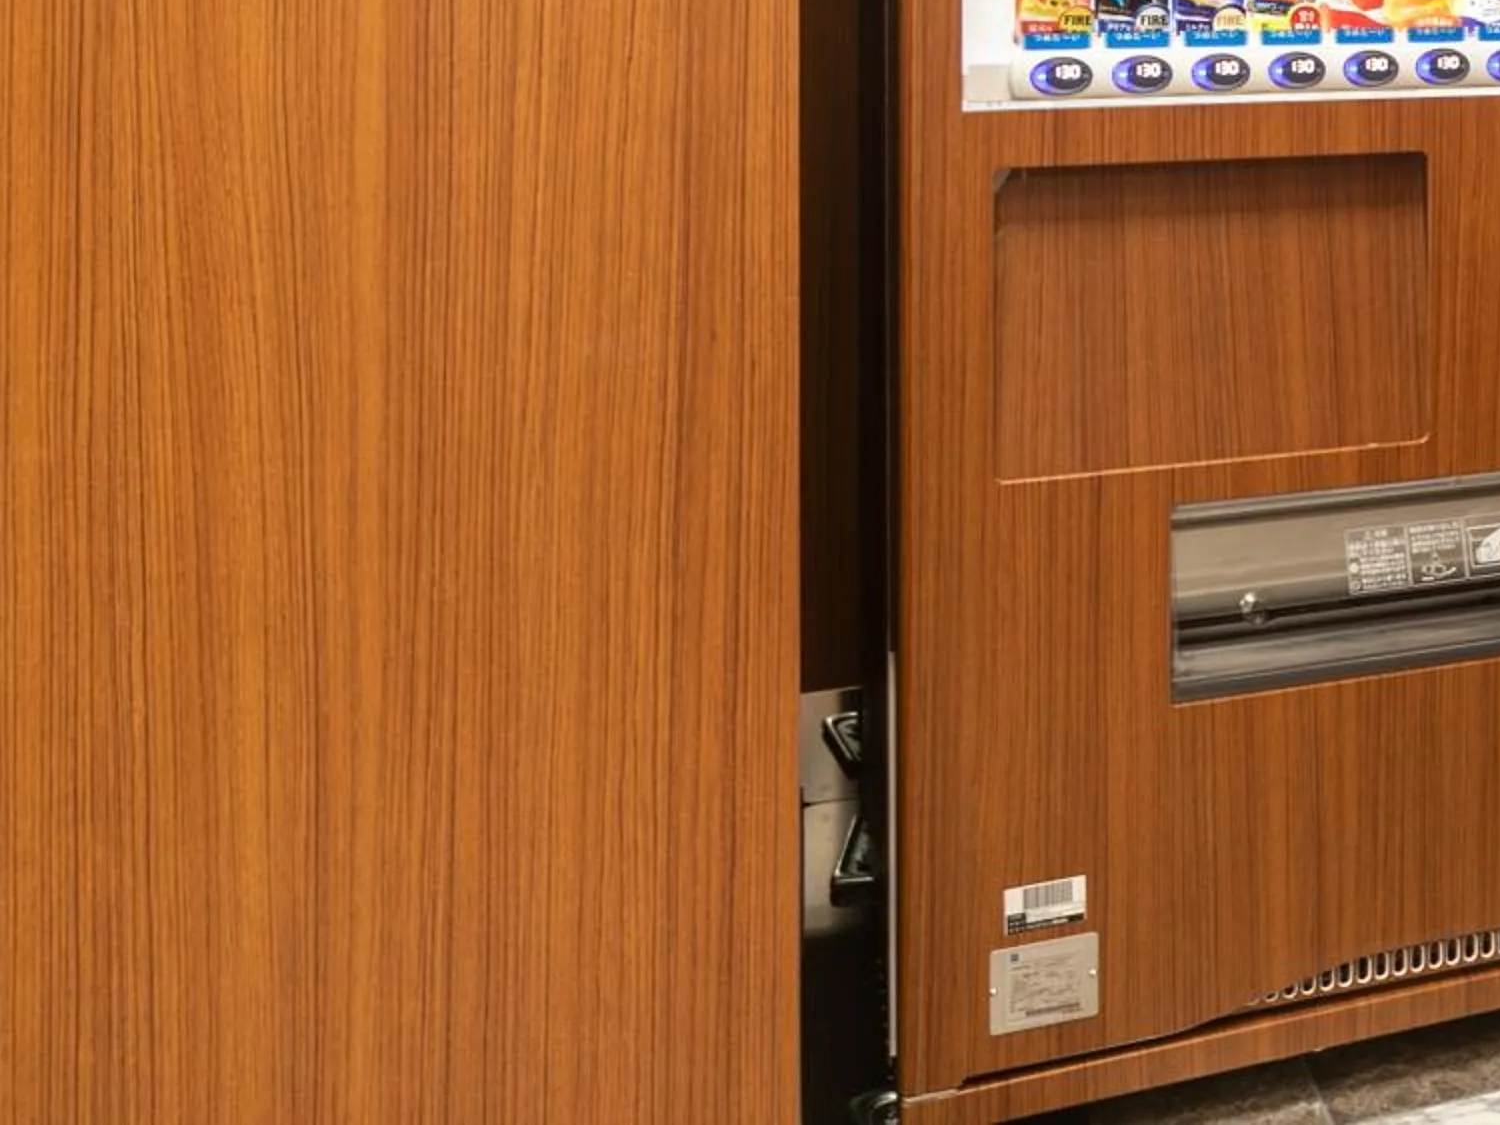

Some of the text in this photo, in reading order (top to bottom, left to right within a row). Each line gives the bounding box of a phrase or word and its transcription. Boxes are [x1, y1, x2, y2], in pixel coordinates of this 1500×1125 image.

[1064, 14, 1093, 27] FIRE
[1140, 15, 1169, 27] FIRE
[1136, 62, 1162, 78] 130
[1215, 60, 1240, 76] 130
[1291, 58, 1316, 74] 130
